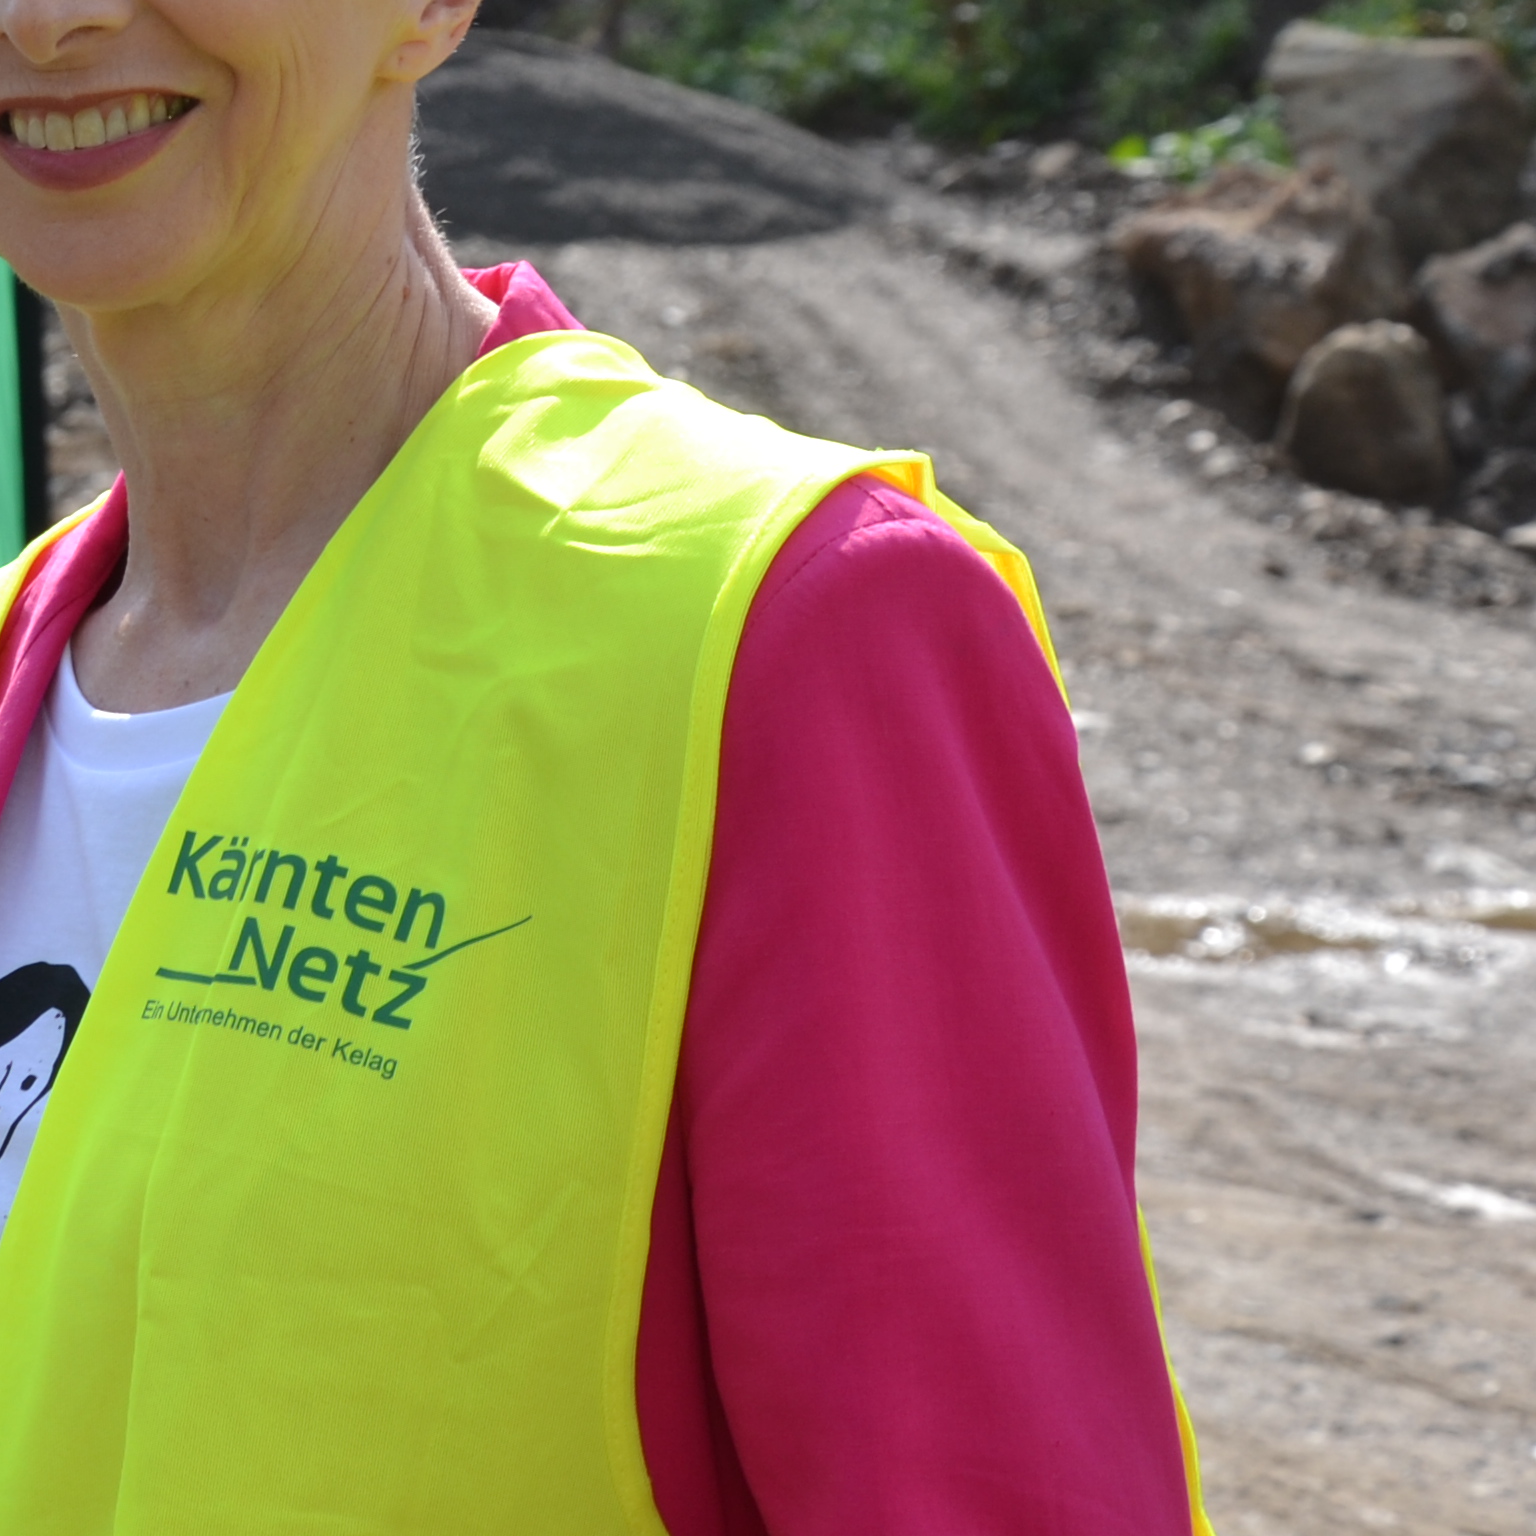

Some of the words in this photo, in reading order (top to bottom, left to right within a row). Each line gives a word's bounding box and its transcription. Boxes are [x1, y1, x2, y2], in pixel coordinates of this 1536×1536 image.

[166, 830, 447, 950] Kärnten
[227, 916, 428, 1031] Netz
[141, 999, 165, 1020] Ein
[166, 1000, 284, 1042] Untenehmen
[287, 1025, 327, 1052] der
[331, 1037, 398, 1080] Kelag
